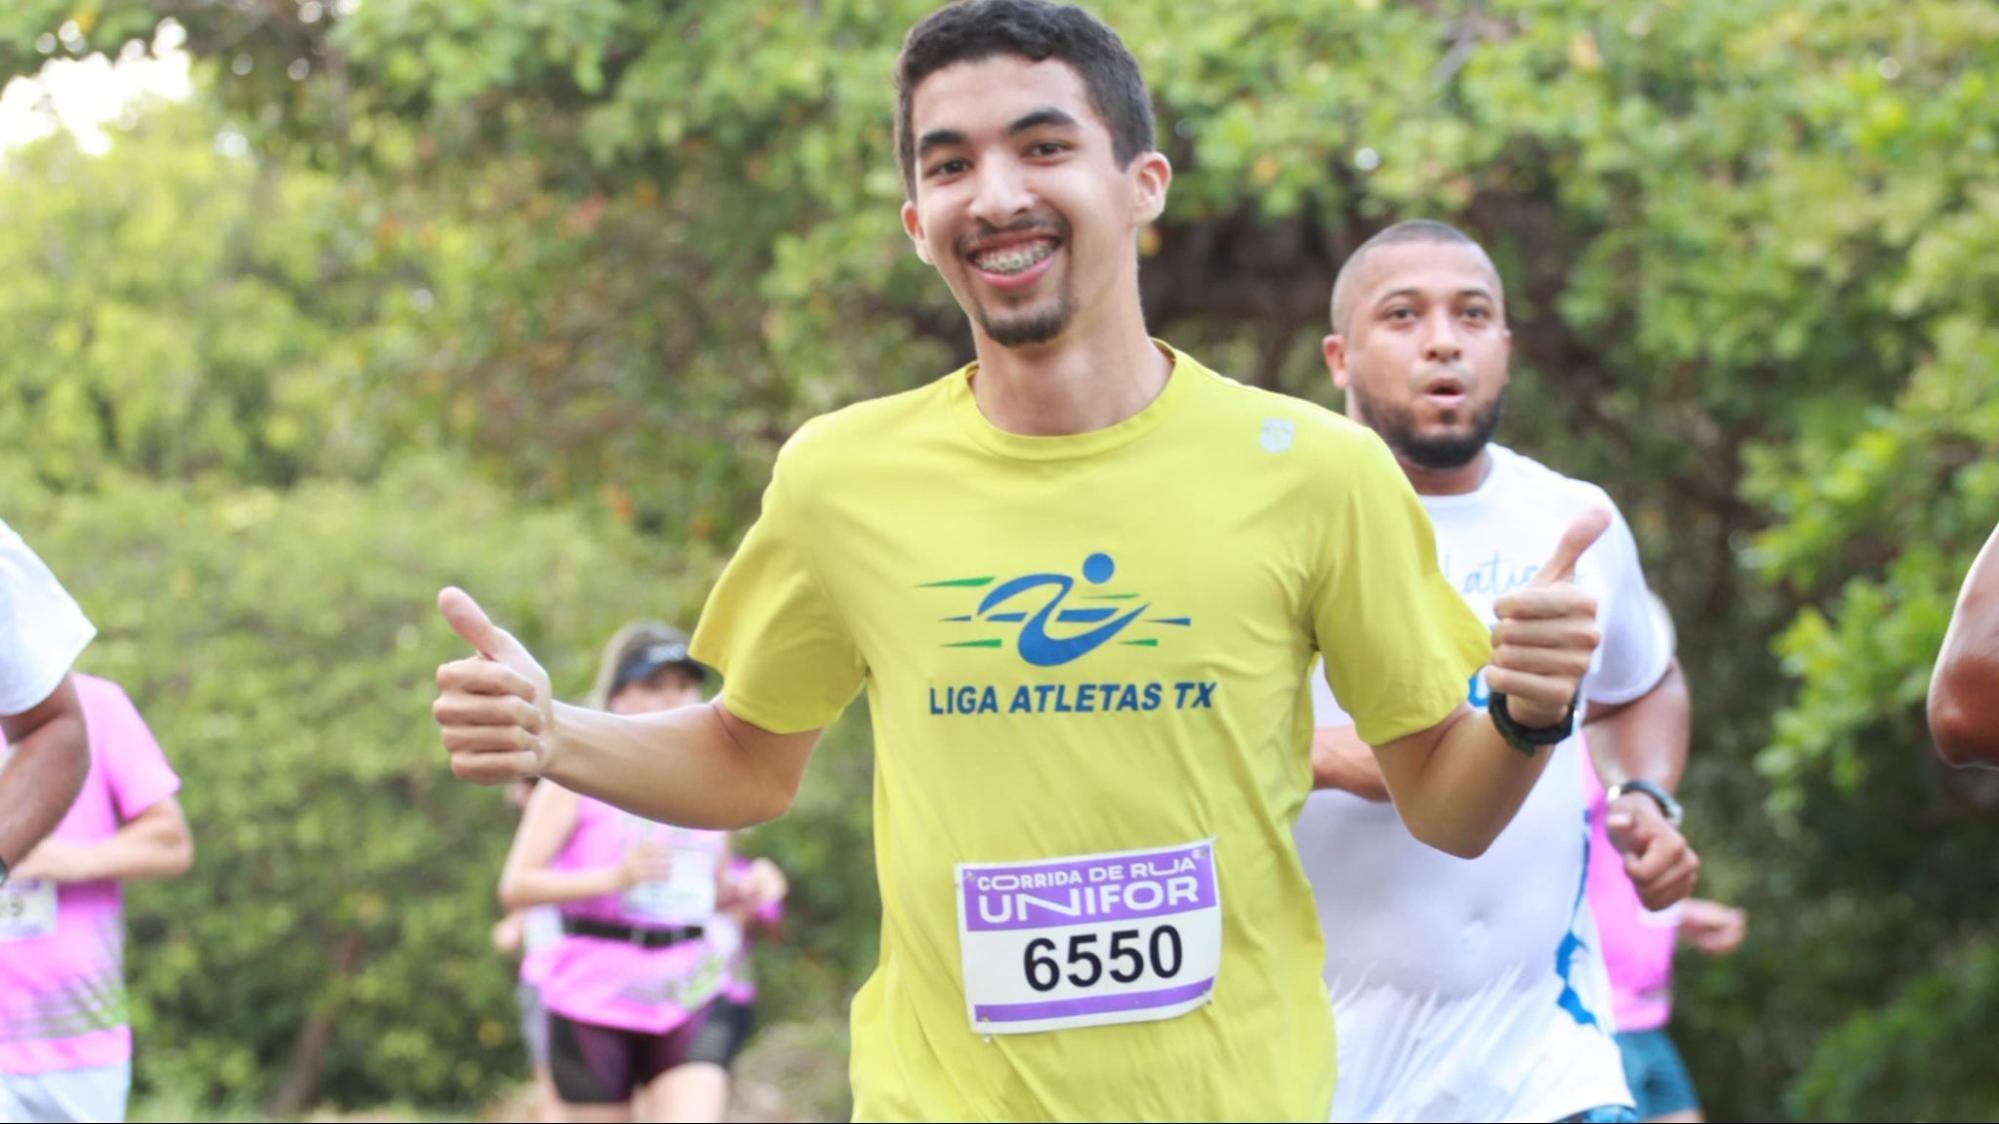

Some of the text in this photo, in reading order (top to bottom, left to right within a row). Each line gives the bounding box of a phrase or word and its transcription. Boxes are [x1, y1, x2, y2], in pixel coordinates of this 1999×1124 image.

[929, 681, 1217, 715] LIGA ATLETAS TX
[977, 857, 1197, 891] CORRIDA DE RUA
[978, 875, 1199, 924] UNIFOR
[1023, 924, 1183, 992] 6550
